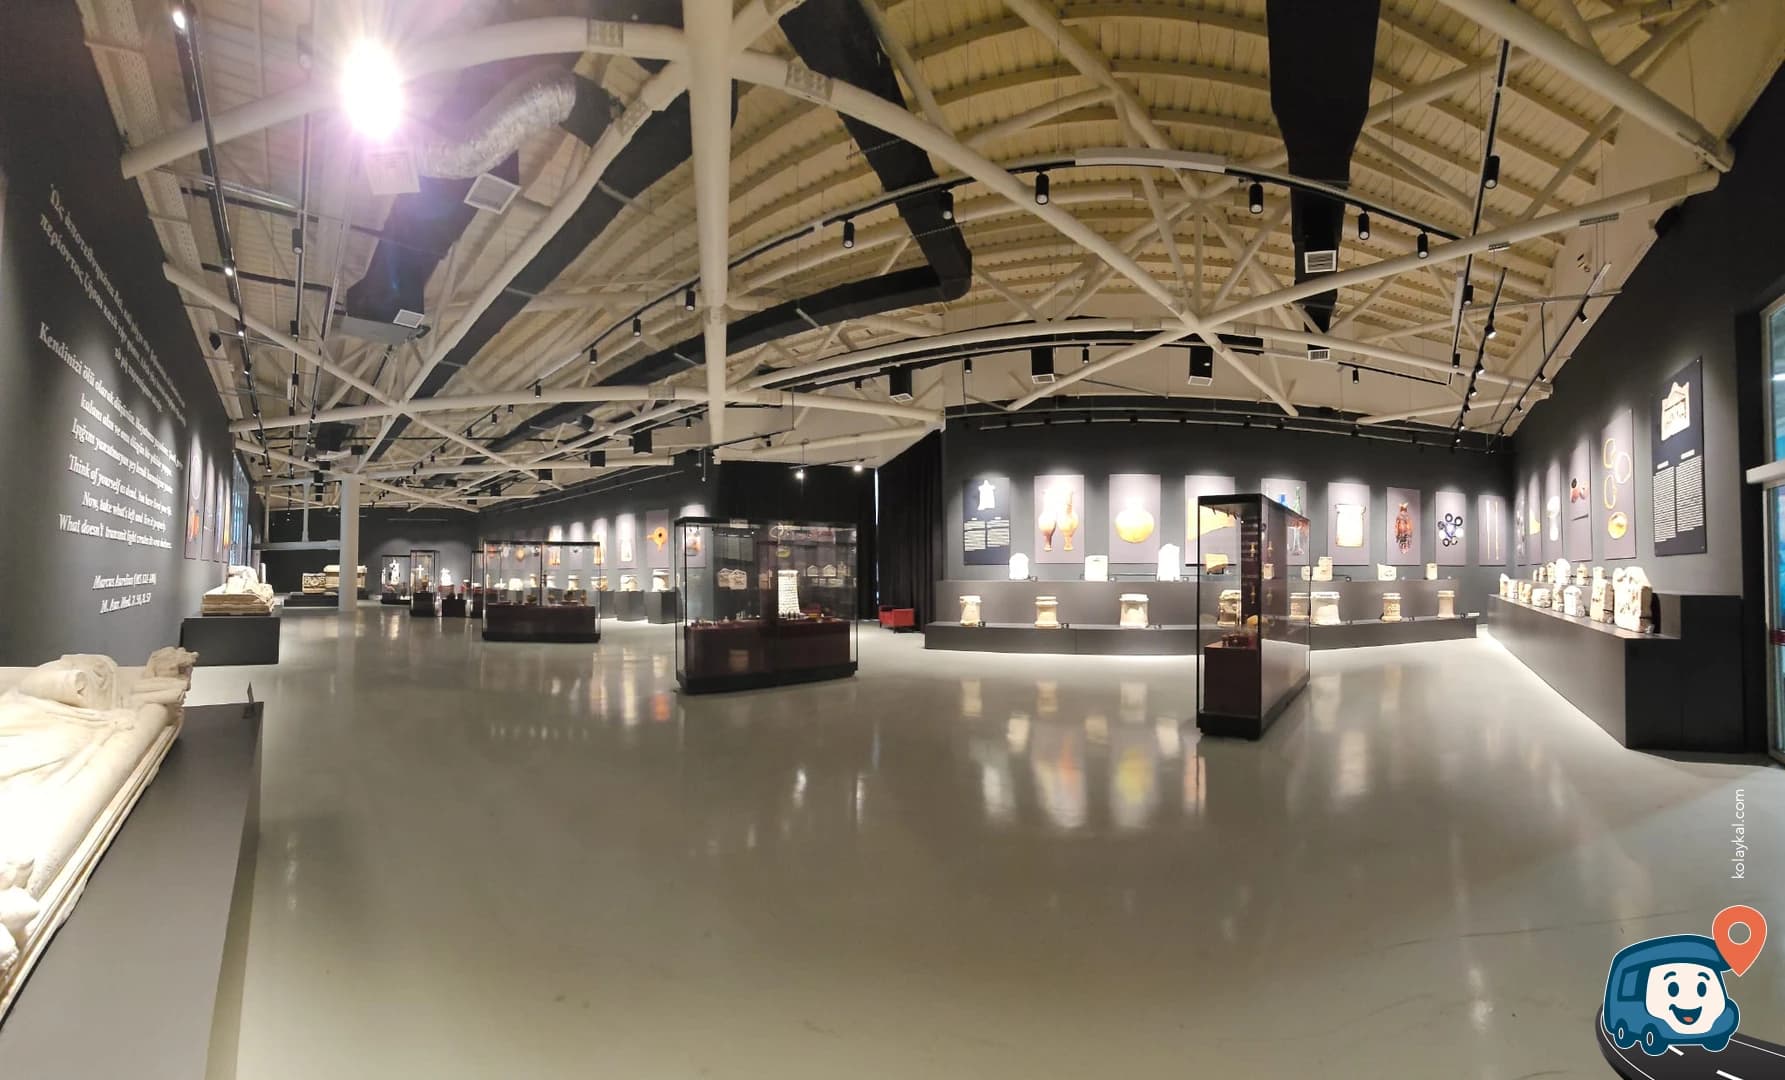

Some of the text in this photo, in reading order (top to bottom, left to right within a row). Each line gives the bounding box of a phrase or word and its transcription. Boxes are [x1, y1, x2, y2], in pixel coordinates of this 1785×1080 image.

[39, 321, 82, 375] Kendinizi
[82, 364, 95, 387] ölü
[95, 379, 114, 406] olarak
[69, 454, 90, 478] Think
[90, 467, 100, 485] of
[97, 473, 120, 495] yourself
[119, 484, 126, 495] as
[82, 491, 99, 511] Now,
[99, 498, 112, 514] take
[134, 512, 143, 523] and
[59, 513, 80, 533] What
[80, 519, 104, 538] doesn't
[92, 575, 115, 589] Marcus
